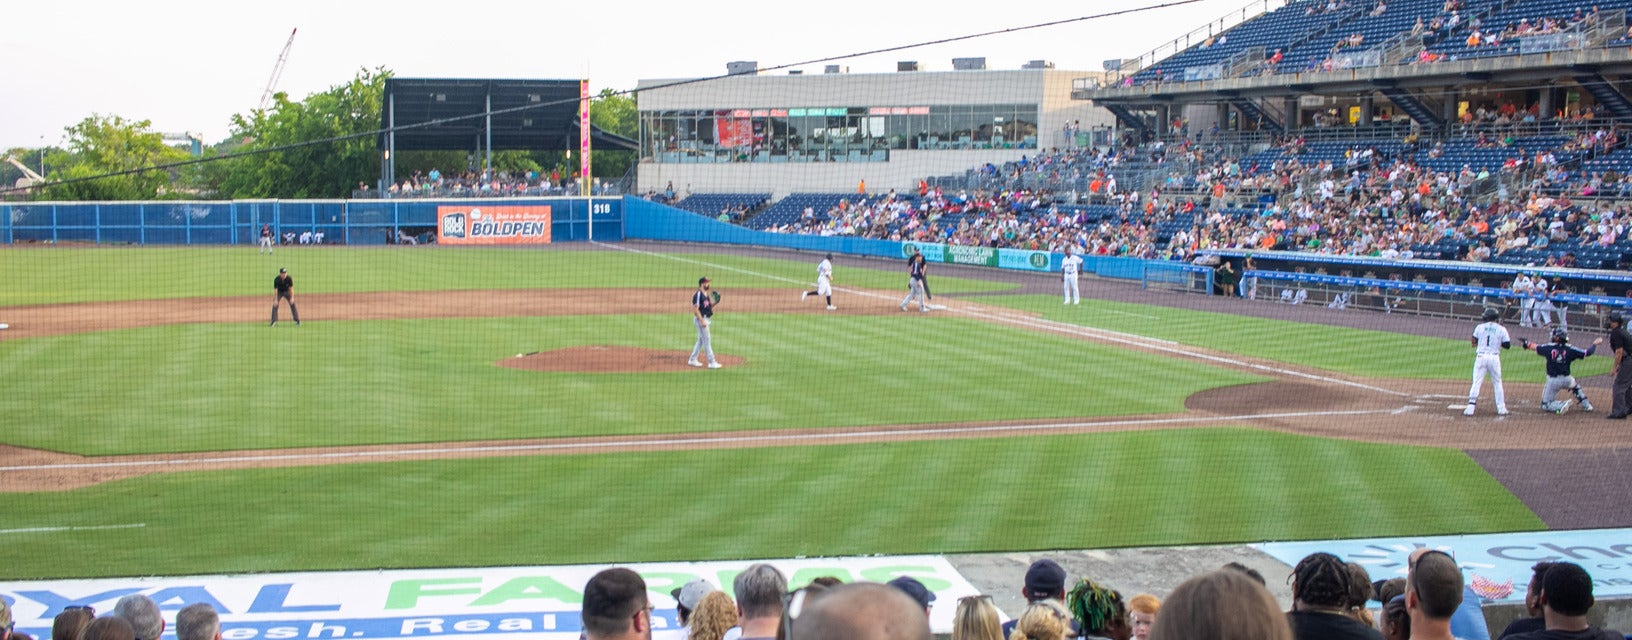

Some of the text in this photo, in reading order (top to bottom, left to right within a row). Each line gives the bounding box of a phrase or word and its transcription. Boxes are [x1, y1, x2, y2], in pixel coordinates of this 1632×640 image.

[594, 204, 610, 214] 318
[444, 216, 464, 226] BOLD
[444, 225, 464, 234] ROCK
[471, 221, 544, 236] BOLDPEN
[401, 614, 576, 635] Real
